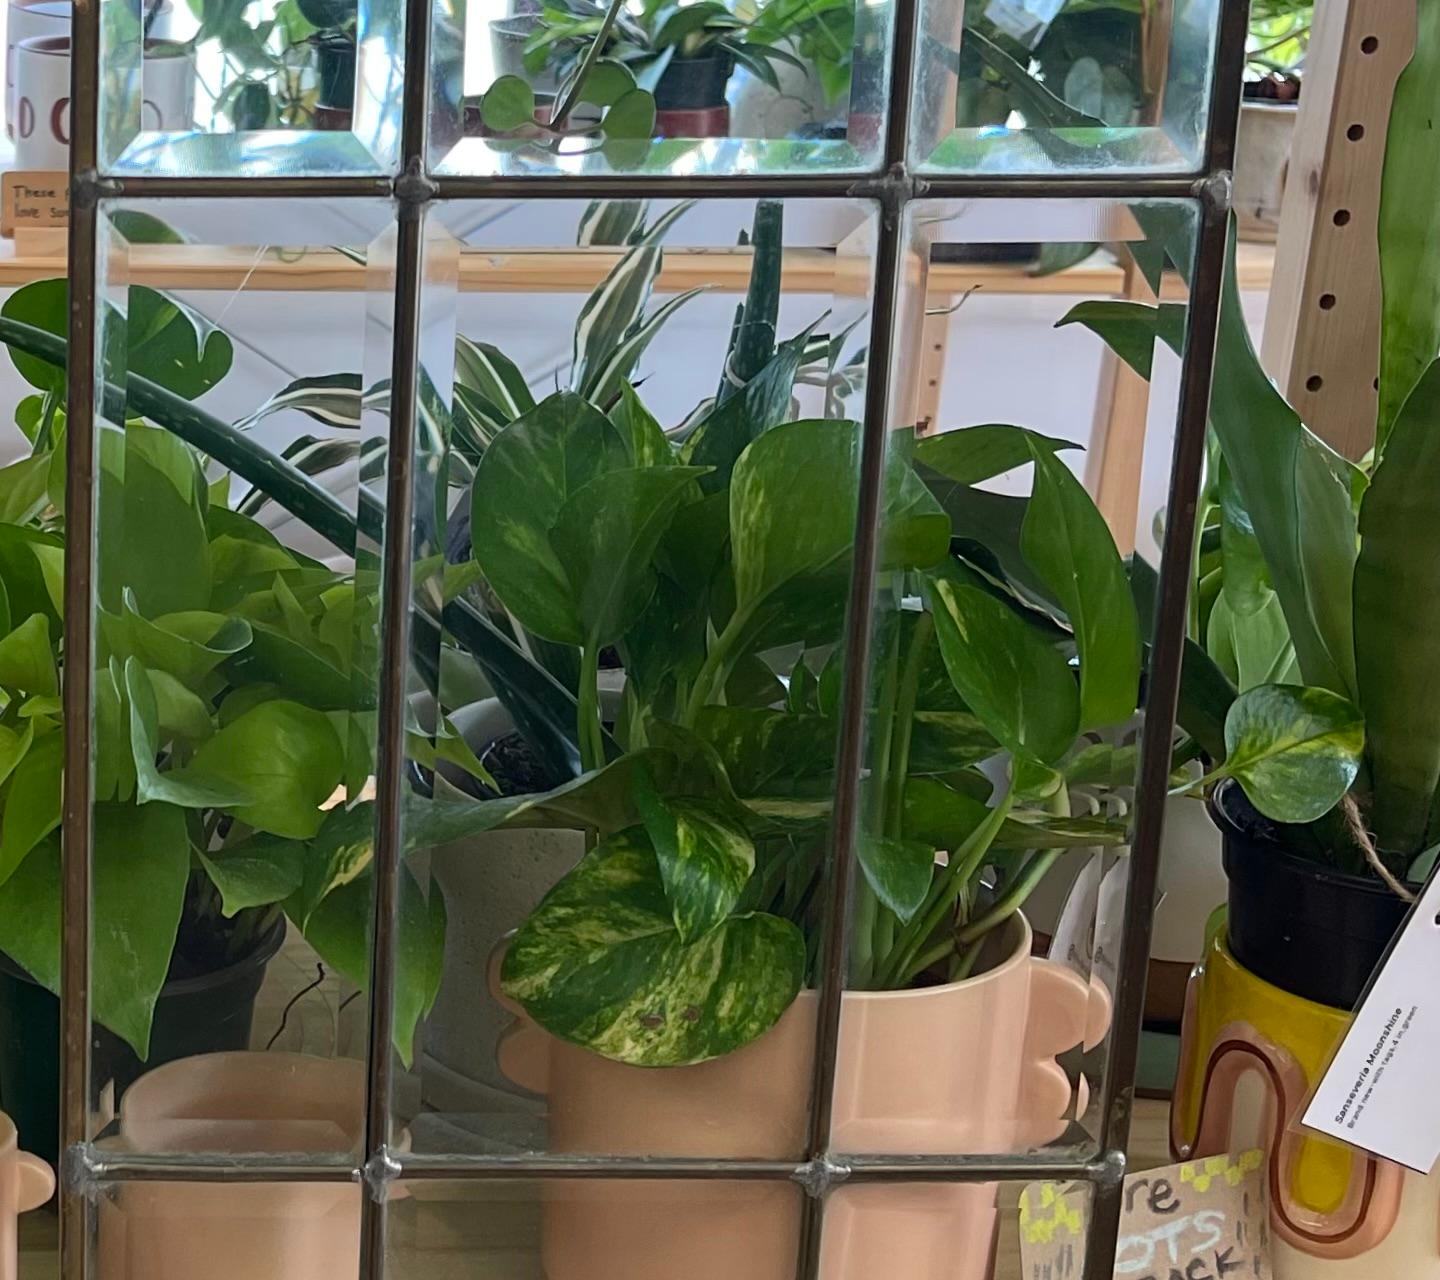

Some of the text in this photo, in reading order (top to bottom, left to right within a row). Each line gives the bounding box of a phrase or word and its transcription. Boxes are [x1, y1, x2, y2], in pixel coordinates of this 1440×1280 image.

[12, 184, 57, 198] These
[1334, 1007, 1403, 1124] Sanseveria Moonshine
[1347, 1104, 1365, 1129] Brand
[1114, 1208, 1226, 1273] OTS
